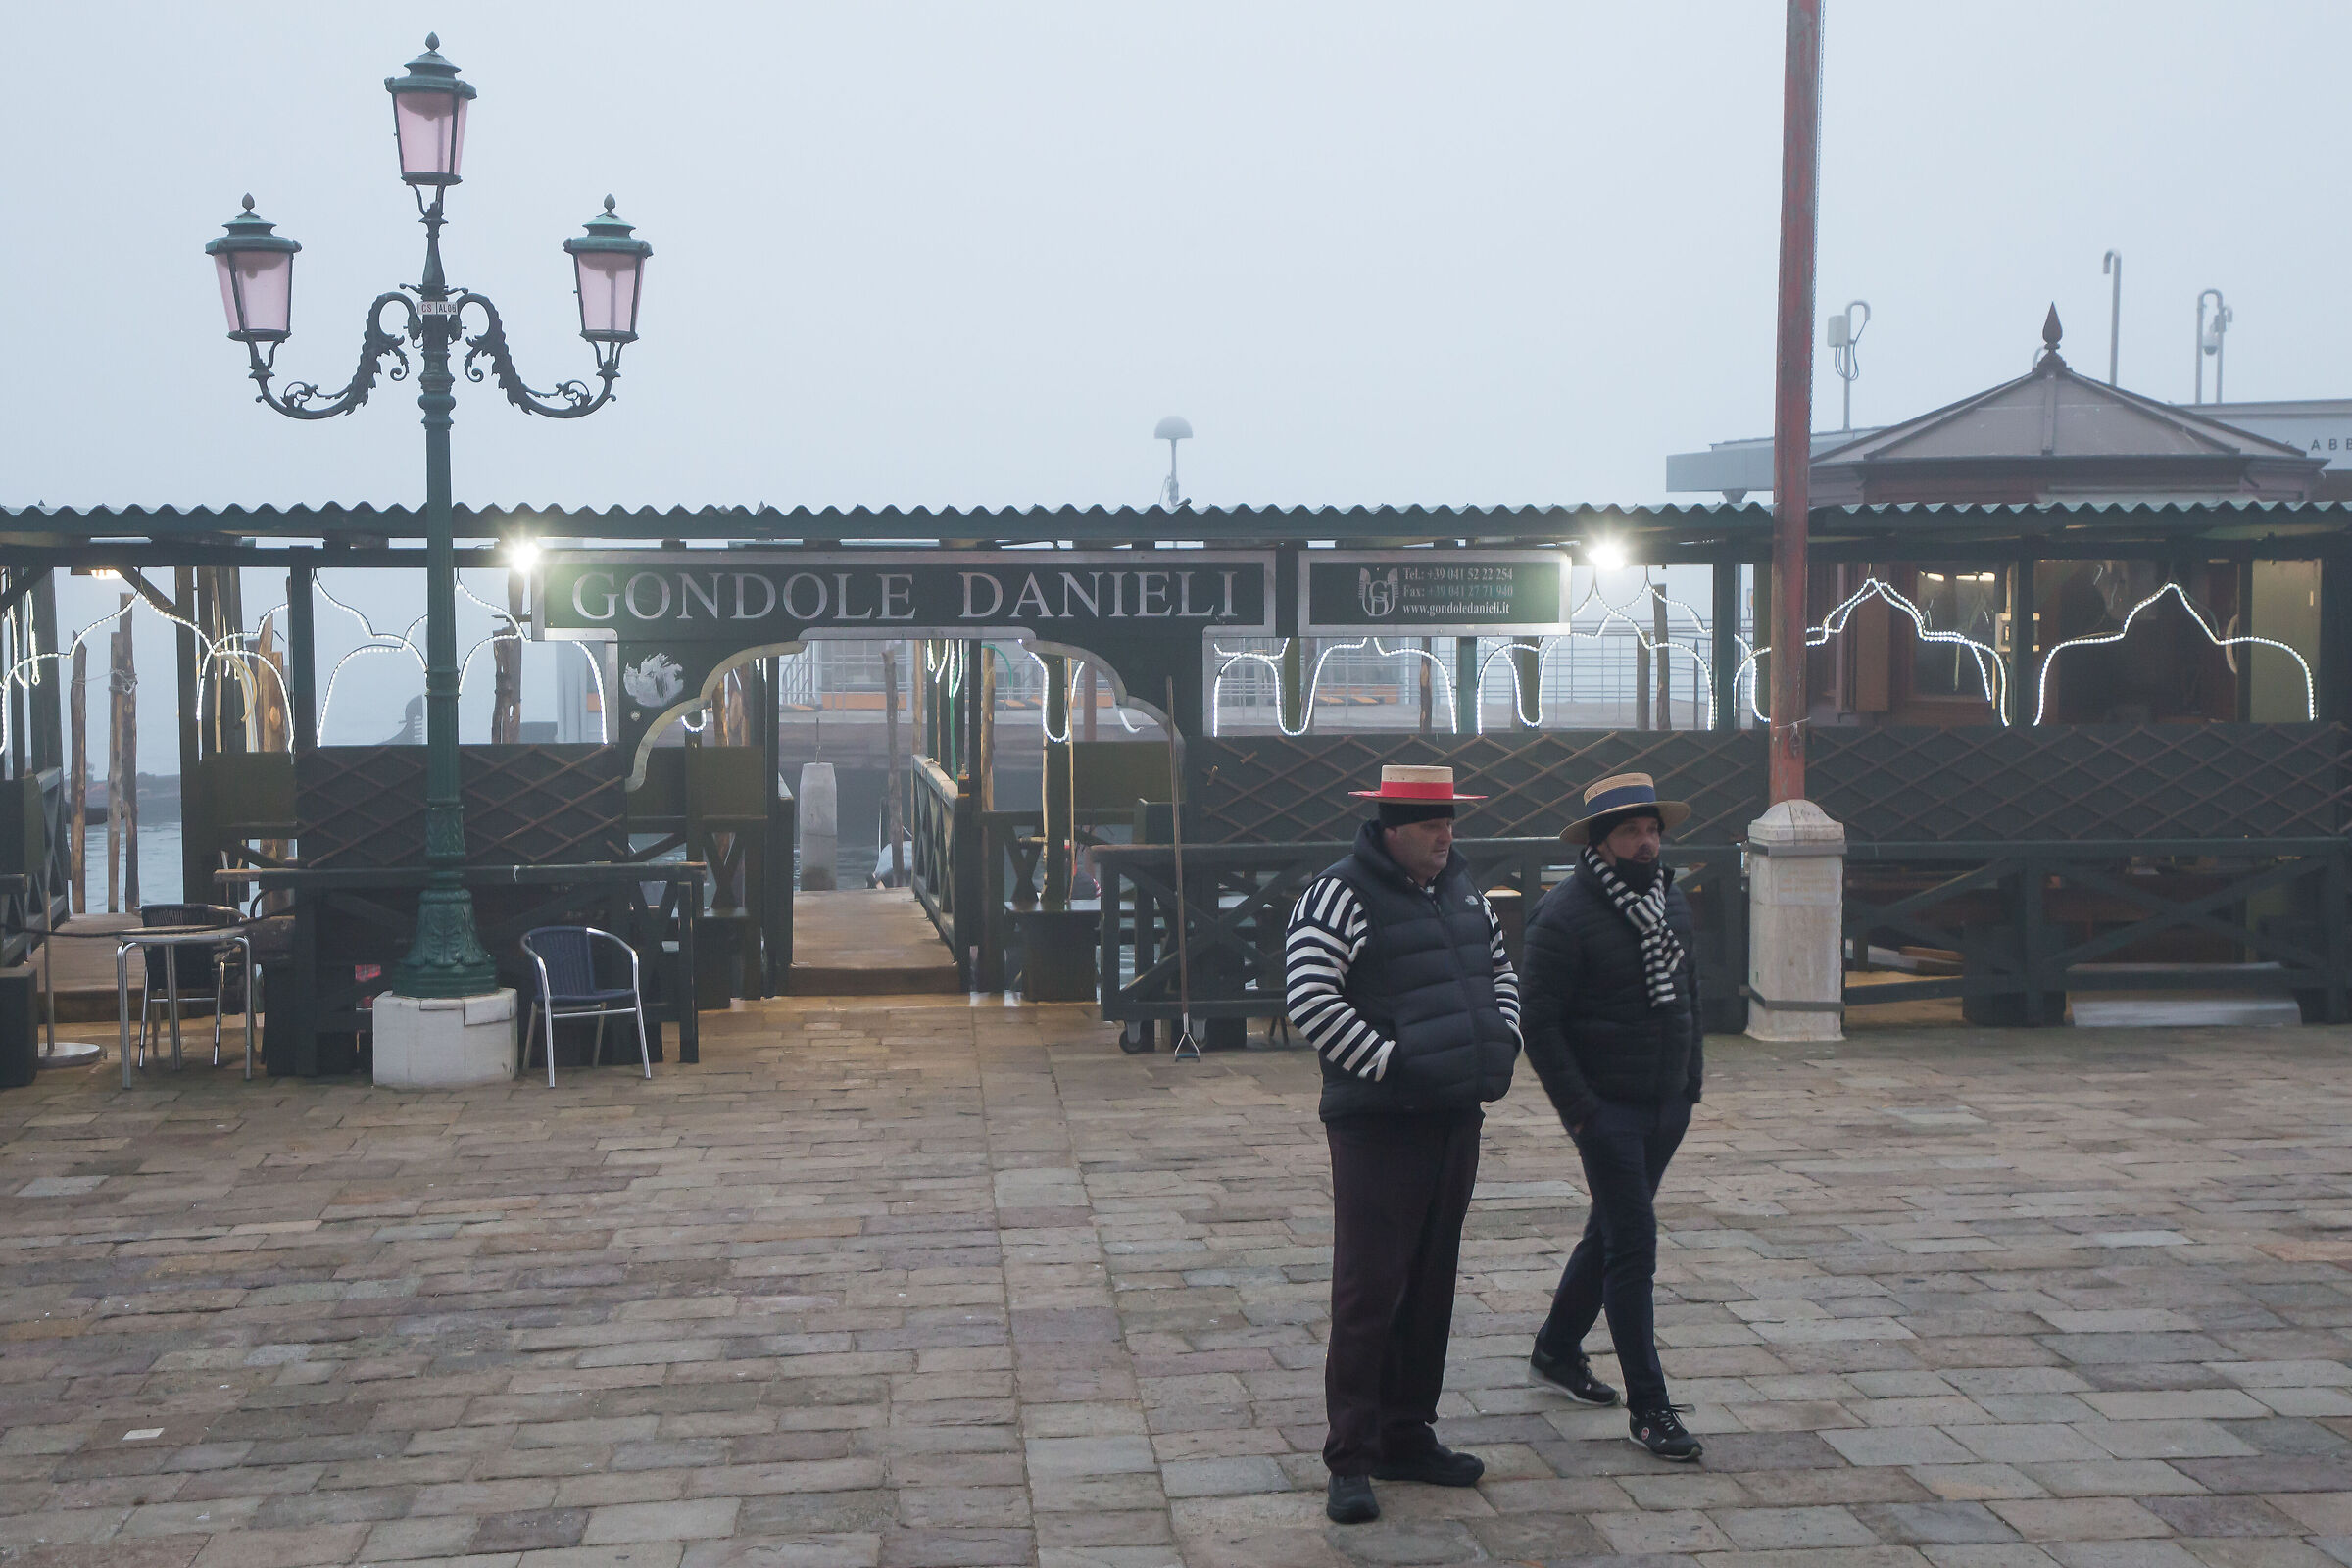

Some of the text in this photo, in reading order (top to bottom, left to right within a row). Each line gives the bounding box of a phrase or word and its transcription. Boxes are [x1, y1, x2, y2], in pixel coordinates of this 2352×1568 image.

[1427, 567, 1445, 580] +39
[1447, 568, 1464, 580] 041
[1467, 568, 1479, 580] 52
[1482, 568, 1494, 580] 22
[1495, 568, 1513, 580] 254
[571, 570, 1239, 622] GONDOLE DANIELI
[1403, 584, 1425, 597] Fax:
[1428, 584, 1446, 597] +39
[1448, 584, 1464, 597] 041
[1483, 584, 1493, 597] 71
[1402, 602, 1510, 617] www.gondoledanieli.it
